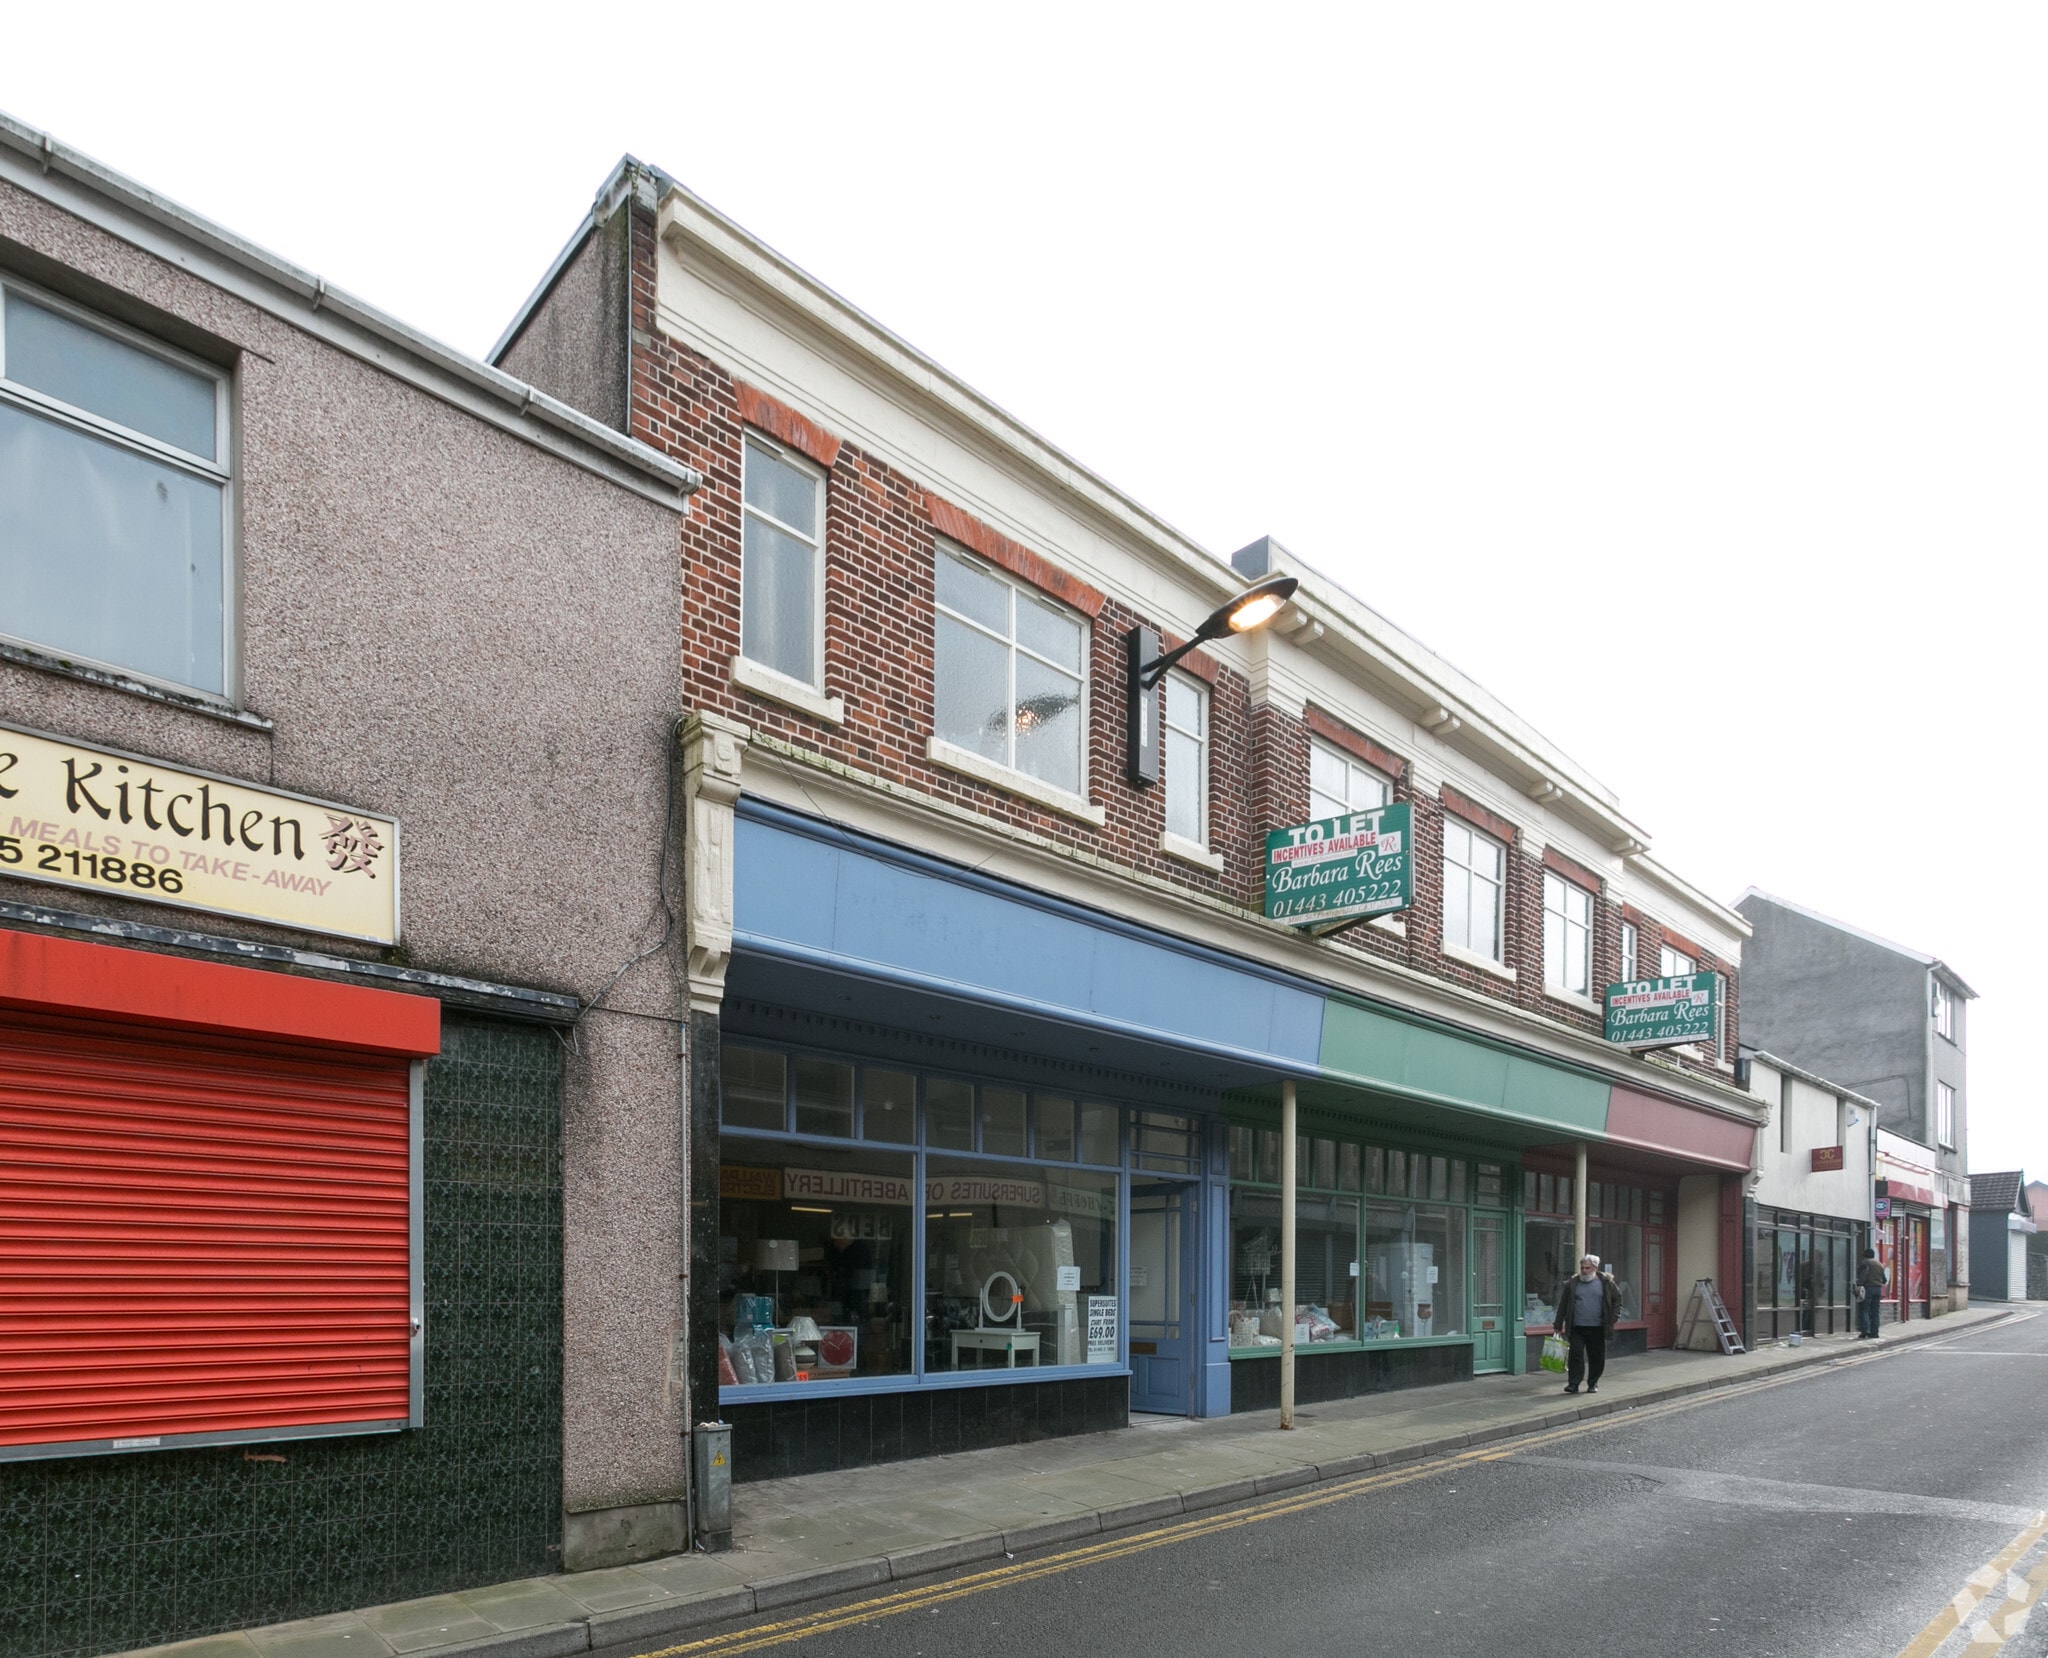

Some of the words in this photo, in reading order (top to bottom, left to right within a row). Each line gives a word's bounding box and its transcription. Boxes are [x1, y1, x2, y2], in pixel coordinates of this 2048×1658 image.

[60, 757, 305, 861] Kitchen
[8, 816, 121, 856] MEALS
[131, 840, 171, 866] TO
[318, 812, 385, 879] 發
[1273, 842, 1324, 861] INCENTIVES
[1327, 831, 1376, 853] AVAILABLE
[1288, 823, 1324, 846] TO
[1332, 810, 1385, 840] LET
[37, 844, 183, 894] 211886
[1272, 864, 1349, 893] Barbara
[1355, 850, 1403, 880] Rees
[1273, 893, 1327, 918] 01443
[1332, 879, 1401, 907] 405222
[1612, 994, 1650, 1006] INCENTIVES
[1654, 989, 1690, 1000] AVAILABLE
[1624, 982, 1651, 995] TO
[1658, 975, 1697, 990] LET
[1611, 1008, 1668, 1026] Barbara
[1674, 1001, 1709, 1021] Rees
[1612, 1027, 1652, 1042] 01443
[1657, 1022, 1709, 1037] 405222
[1089, 1326, 1115, 1339] £69.00
